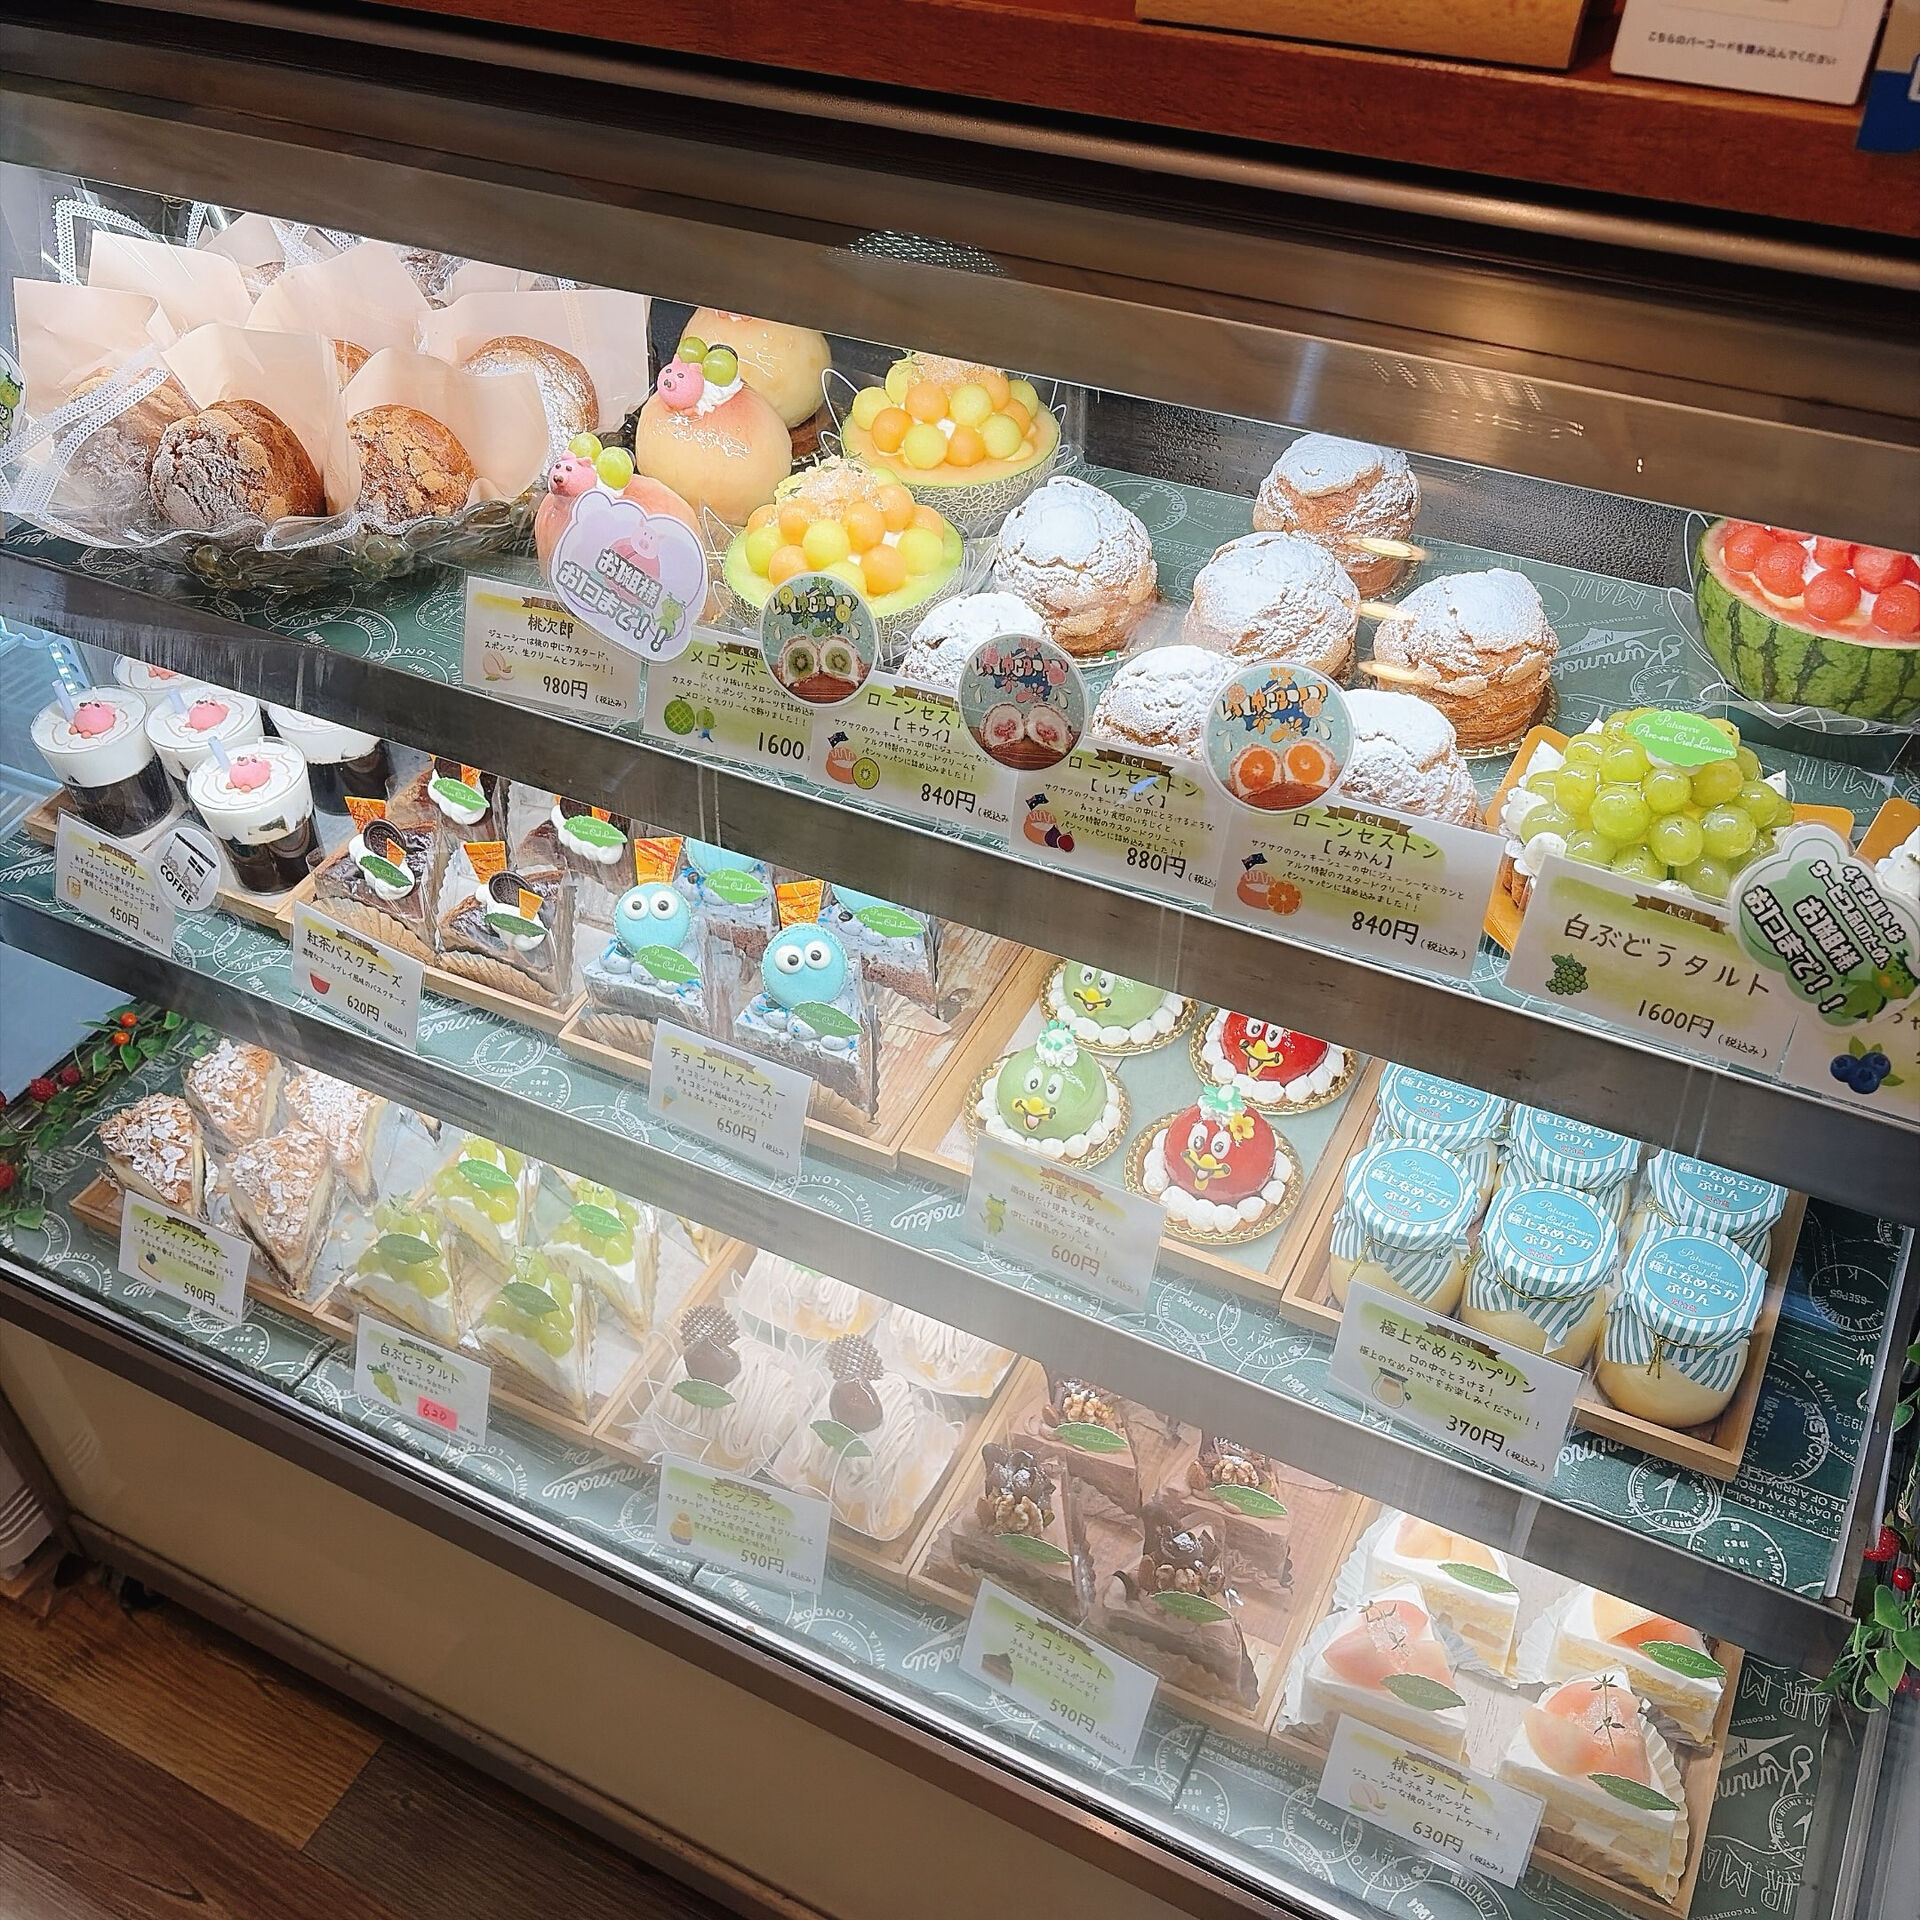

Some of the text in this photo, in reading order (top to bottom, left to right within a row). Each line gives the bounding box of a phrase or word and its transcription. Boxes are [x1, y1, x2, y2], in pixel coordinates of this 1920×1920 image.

[527, 613, 574, 639] 桃次郎
[543, 675, 588, 700] 980円
[921, 783, 976, 814] 840円
[1293, 812, 1440, 861] ローンセストン
[87, 847, 145, 881] コーヒーゼリー
[1127, 848, 1187, 879] 880円
[1323, 839, 1393, 870] 【みかん】
[160, 864, 193, 906] COFFEE
[110, 906, 140, 930] 450円
[1842, 864, 1907, 945] 4号タルトは
[1352, 911, 1467, 960] 840円 (税込み)
[1793, 894, 1865, 976] お1組様
[306, 929, 403, 988] 紅茶バスクチーズ
[1564, 913, 1770, 996] 白ぶどうタルト
[347, 995, 380, 1022] 620円
[1637, 999, 1768, 1059] 1600円 (税込み)
[670, 1046, 786, 1097] チョコットスースー
[1414, 1093, 1452, 1113] ぷりん
[717, 1117, 757, 1144] 650円
[1554, 1132, 1596, 1149] ぷりん
[1383, 1191, 1423, 1214] ぷりん
[1696, 1180, 1741, 1202] ぷりん
[143, 1216, 228, 1259] インディアンサマー
[1522, 1233, 1565, 1255] ぷりん
[1051, 1244, 1100, 1277] 600円
[184, 1282, 215, 1306] 590円
[1664, 1283, 1709, 1307] ぷりん
[380, 1342, 460, 1384] 白ぶどうタルト
[1379, 1318, 1537, 1394] 極上なめらかプリン
[1359, 1344, 1541, 1430] 極上のなめらかさをお楽しみください！！
[1409, 1353, 1494, 1397] 口の中でとろける！
[1446, 1414, 1546, 1473] 370円 (税込み)
[709, 1484, 775, 1511] モンブラン
[740, 1550, 785, 1574] 590円
[1013, 1621, 1107, 1680] チョコショート
[1049, 1698, 1096, 1733] 590円
[1392, 1757, 1474, 1801] 桃ショート
[1412, 1821, 1464, 1854] 630円
